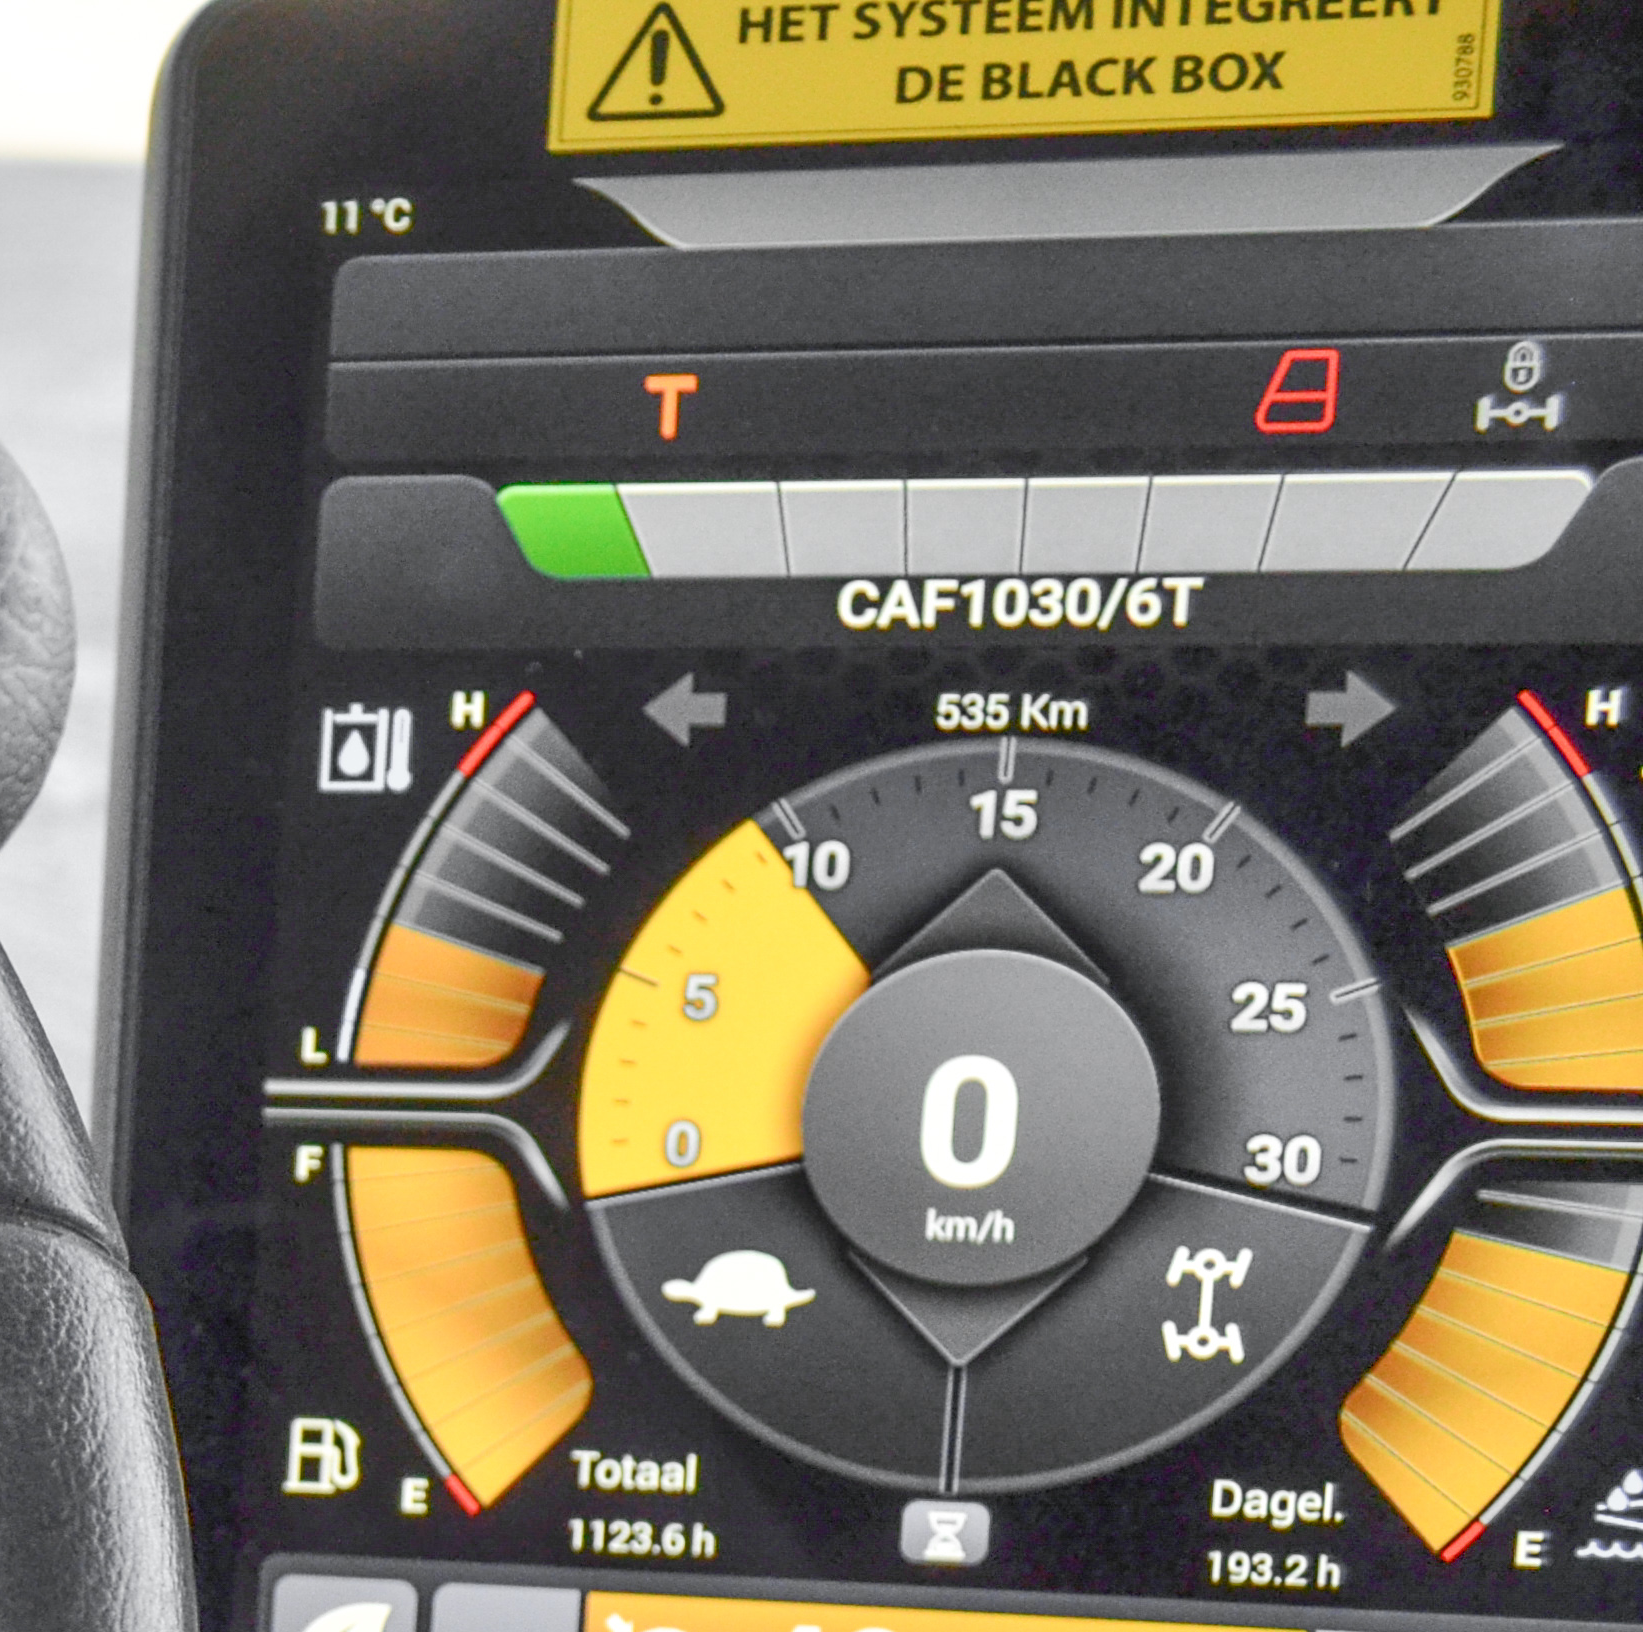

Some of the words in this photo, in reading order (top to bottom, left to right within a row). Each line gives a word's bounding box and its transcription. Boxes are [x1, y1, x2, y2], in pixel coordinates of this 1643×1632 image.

[738, 4, 839, 43] HET
[852, 0, 1095, 40] SYSTEEM
[894, 64, 965, 104] DE
[980, 57, 1156, 101] BLACK
[1171, 51, 1285, 94] BOX
[1452, 33, 1475, 101] 930788
[321, 200, 361, 235] 11
[644, 373, 699, 440] T
[837, 576, 1206, 631] CAF1030/6T
[450, 690, 486, 730] H
[935, 692, 1011, 731] 535
[1019, 693, 1089, 731] Km
[1584, 688, 1625, 728] H
[969, 788, 1039, 839] 15
[783, 840, 851, 891] 10
[1137, 842, 1216, 894] 20
[683, 973, 719, 1022] 5
[1229, 981, 1310, 1034] 25
[301, 1026, 329, 1065] L
[664, 1119, 702, 1168] 0
[920, 1054, 1019, 1190] 0
[295, 1145, 323, 1184] F
[1243, 1133, 1323, 1186] 30
[924, 1206, 1016, 1245] km/h
[571, 1449, 699, 1494] Totaal
[399, 1478, 430, 1516] E
[1210, 1478, 1346, 1530] Dagel.
[568, 1518, 686, 1556] 1123.6
[691, 1522, 717, 1558] h
[1514, 1529, 1551, 1568] E
[1207, 1549, 1308, 1588] 193.2
[1316, 1554, 1344, 1590] h
